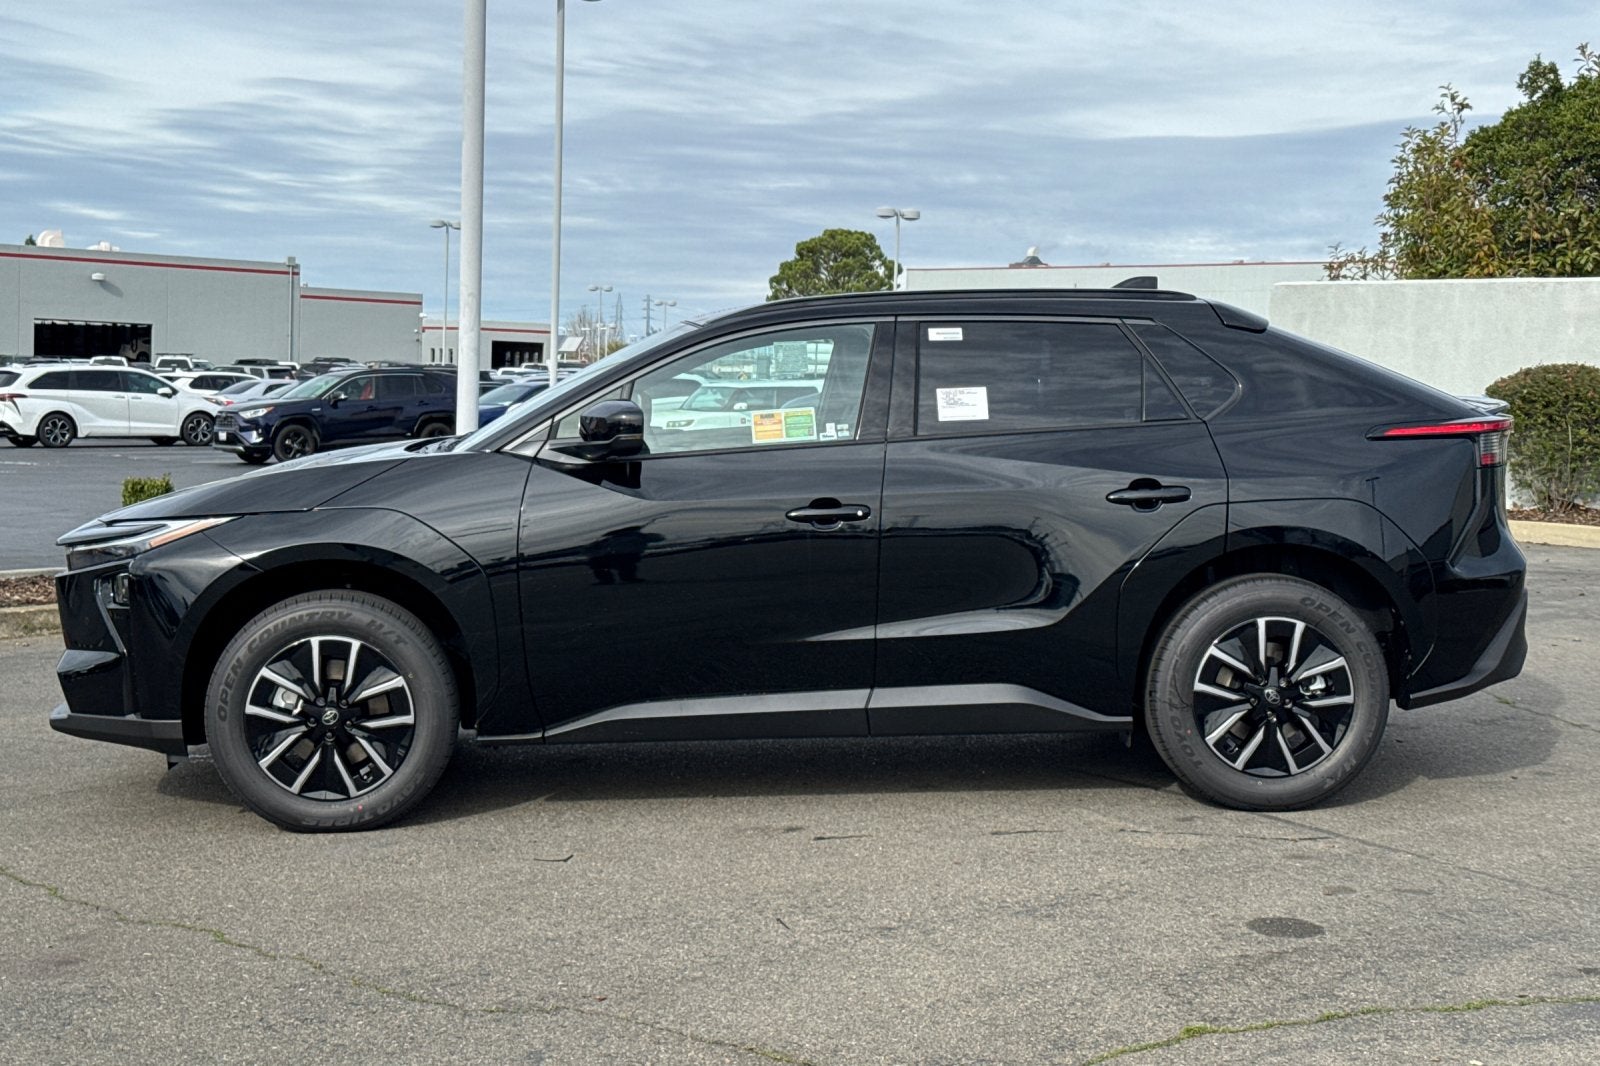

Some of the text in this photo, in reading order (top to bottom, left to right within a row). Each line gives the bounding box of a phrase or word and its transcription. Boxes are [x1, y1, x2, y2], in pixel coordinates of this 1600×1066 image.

[1299, 596, 1357, 635] OPEN
[217, 610, 410, 722] OPEN COUNTRY H/T
[1170, 716, 1203, 769] TOYO
